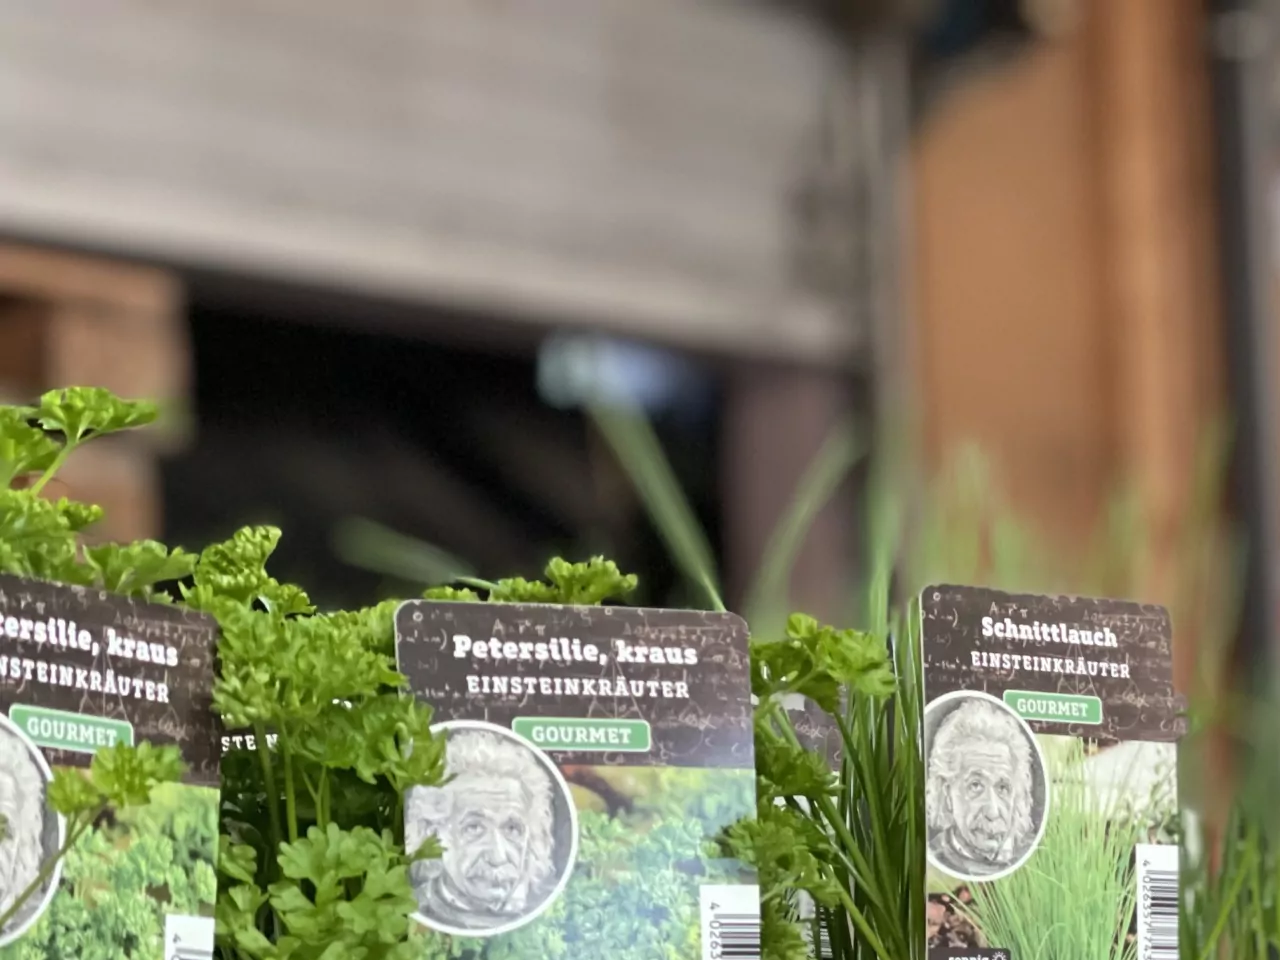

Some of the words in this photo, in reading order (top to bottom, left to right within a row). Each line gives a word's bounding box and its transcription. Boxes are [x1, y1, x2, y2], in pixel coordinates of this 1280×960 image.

[981, 616, 1118, 648] Schnittlauch
[106, 628, 178, 667] kraus
[452, 634, 608, 666] Petersilie,
[616, 639, 698, 665] kraus
[970, 651, 1131, 679] EINSTEINKRÄUTER
[466, 674, 690, 700] EINSTEINKRÄUTER
[1016, 697, 1089, 718] GOURMET
[27, 717, 118, 747] GOURMET
[531, 724, 632, 745] GOURMET
